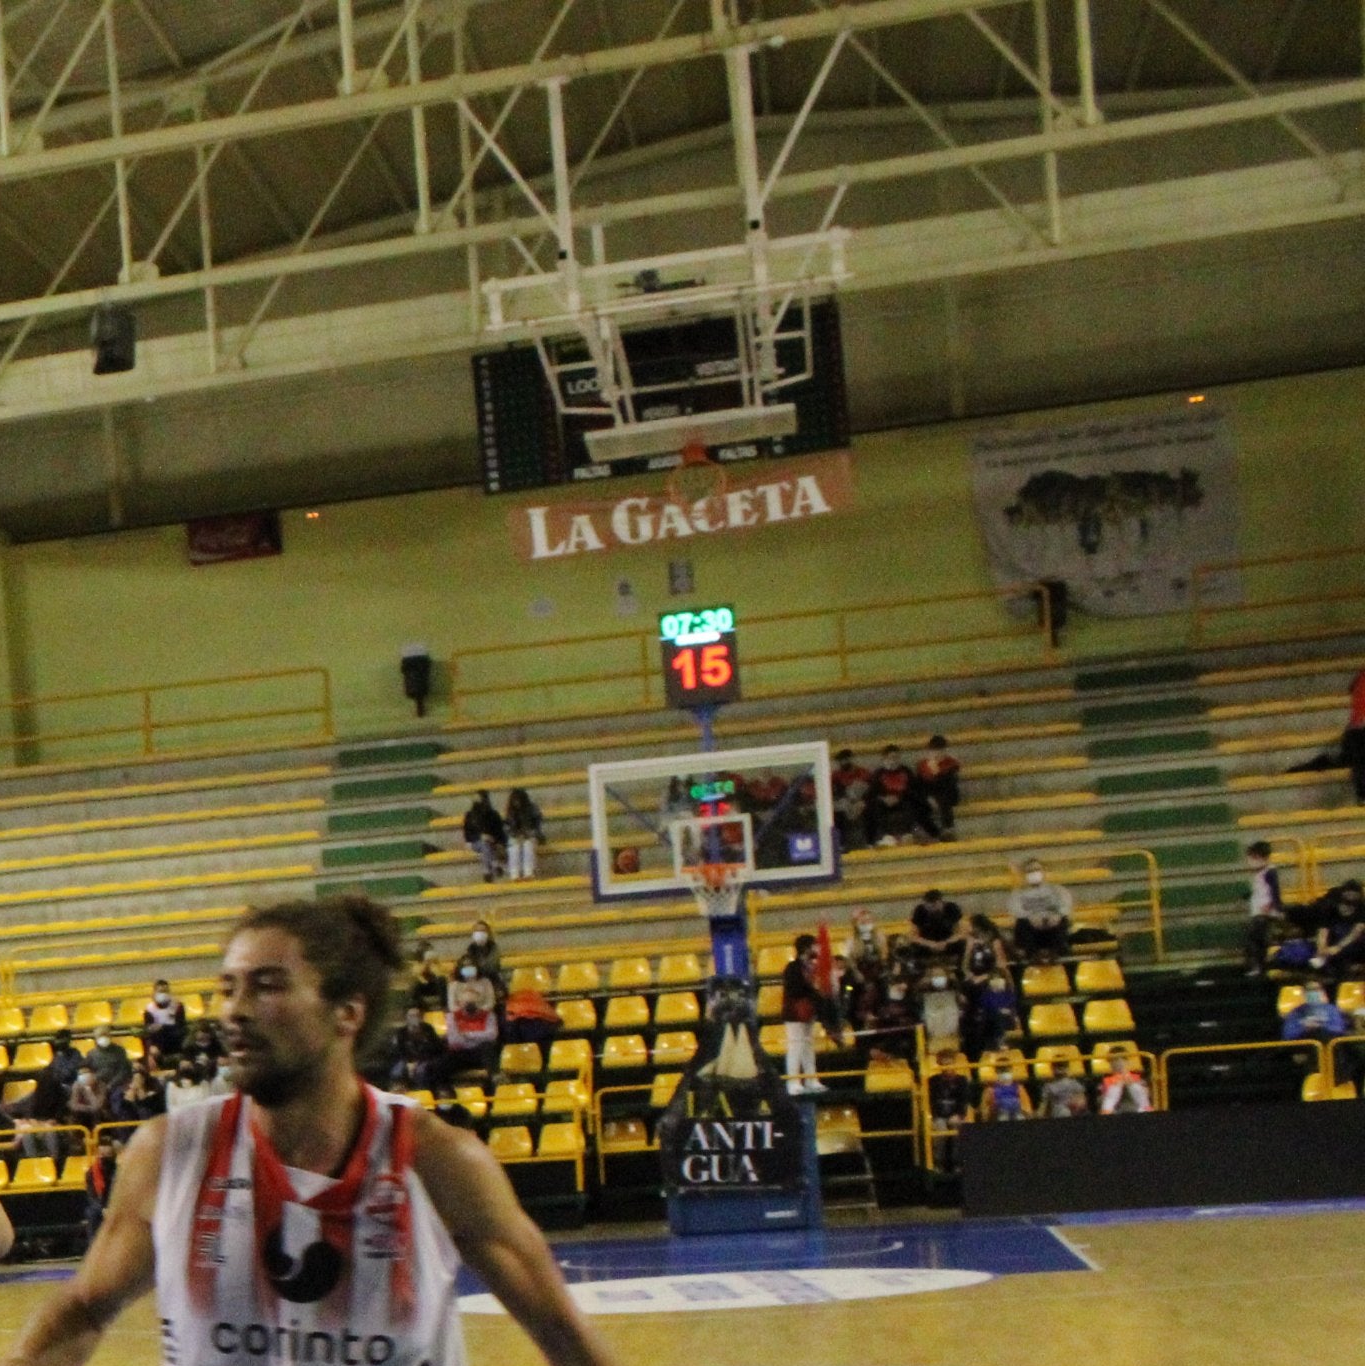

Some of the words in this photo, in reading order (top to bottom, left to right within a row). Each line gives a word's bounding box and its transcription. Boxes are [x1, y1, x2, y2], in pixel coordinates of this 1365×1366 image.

[611, 474, 833, 546] GACETA
[660, 606, 733, 638] 07:30
[671, 644, 732, 691] 15
[681, 1153, 759, 1184] GUA
[210, 1318, 397, 1366] corinto
